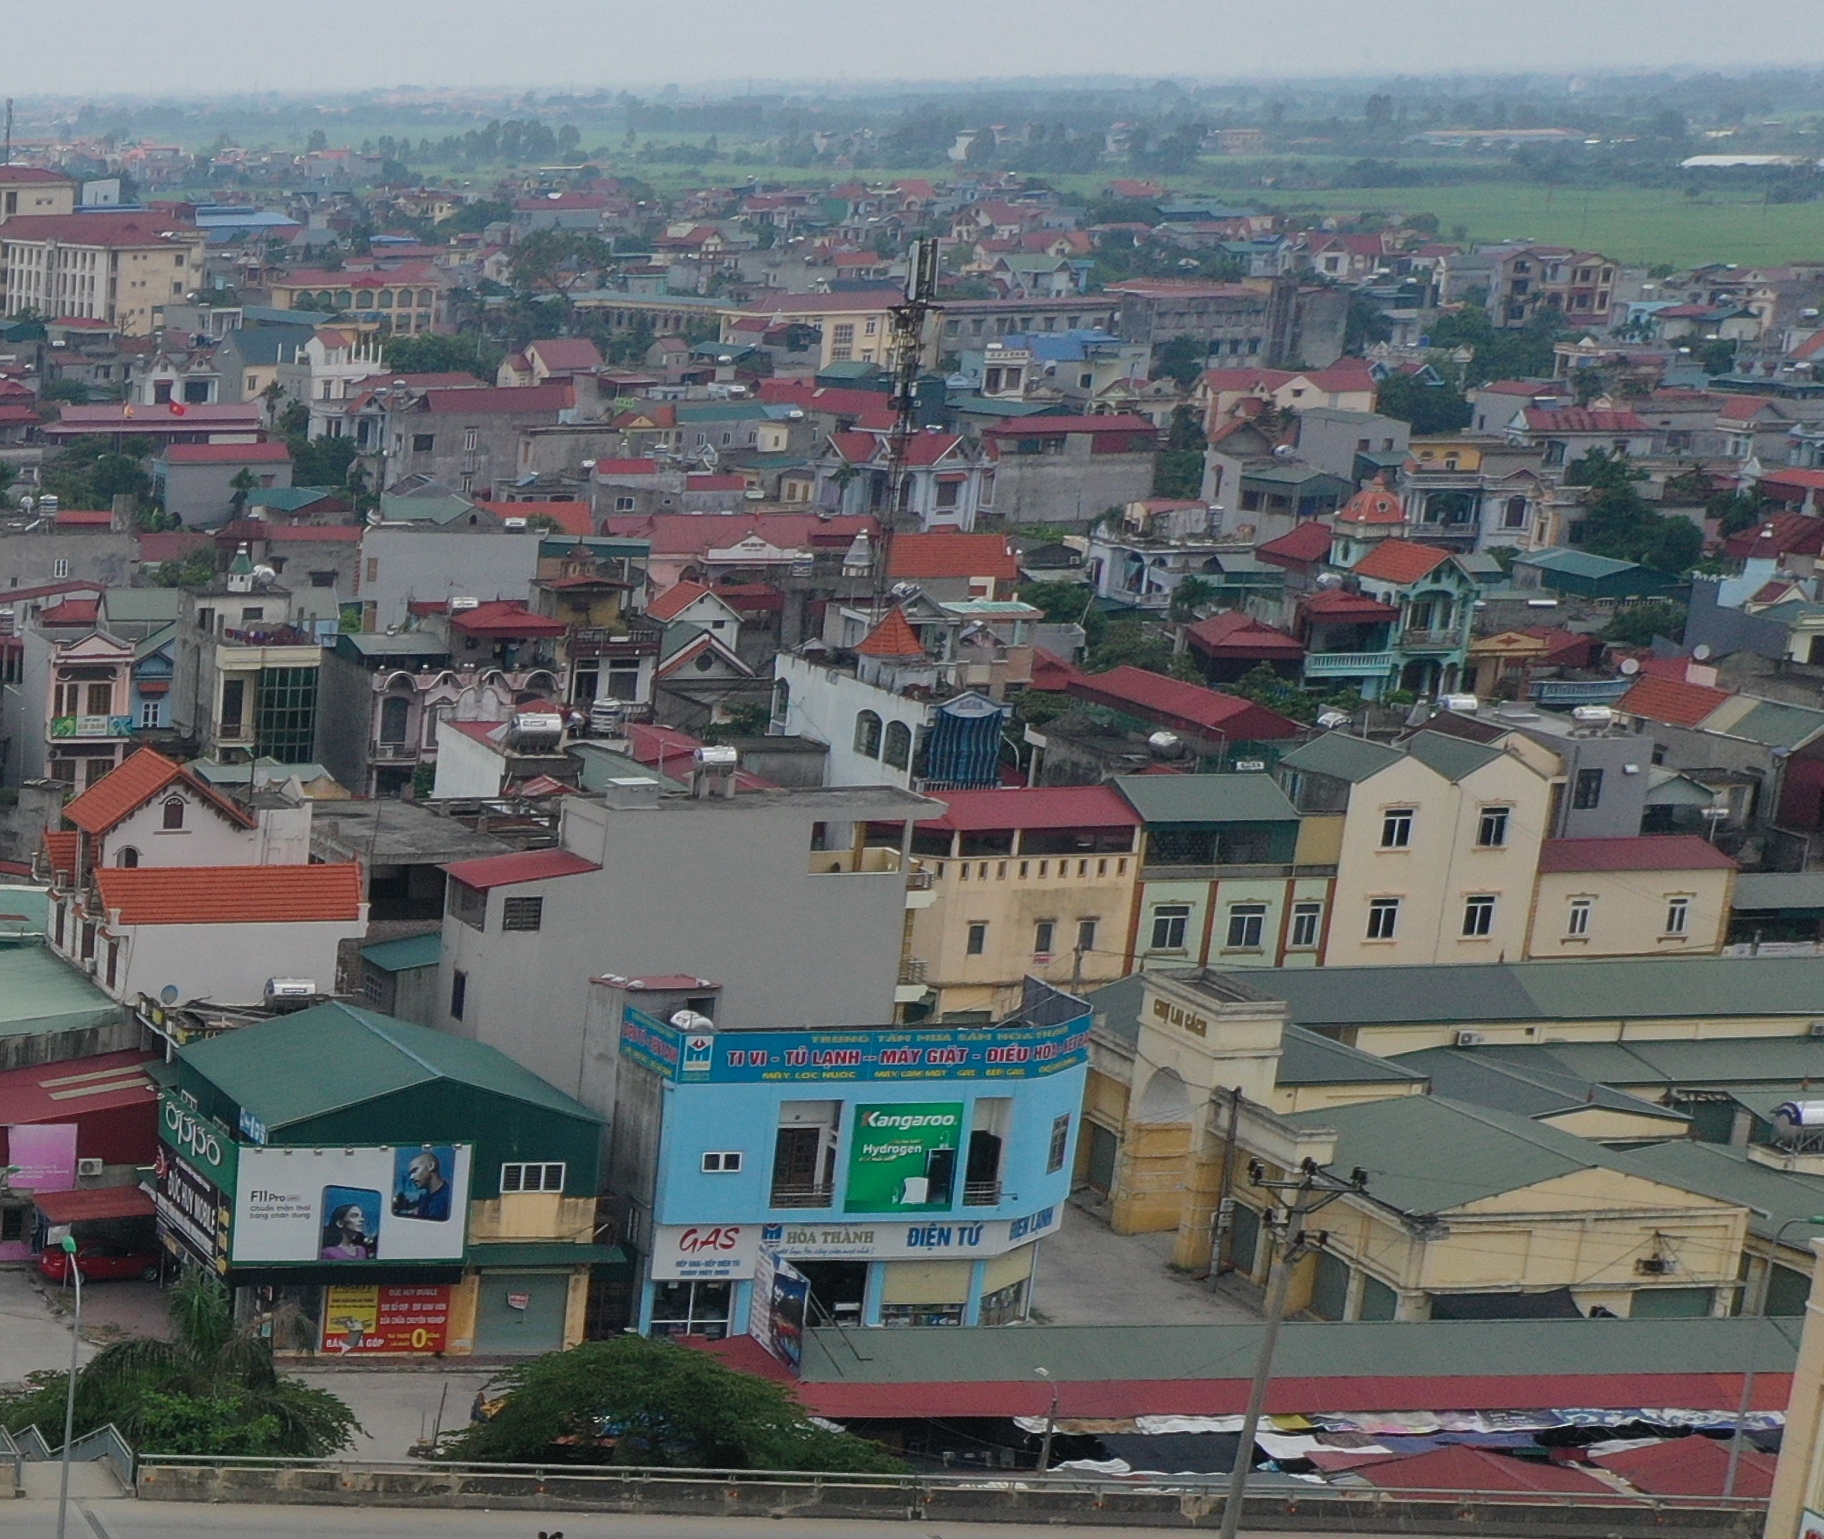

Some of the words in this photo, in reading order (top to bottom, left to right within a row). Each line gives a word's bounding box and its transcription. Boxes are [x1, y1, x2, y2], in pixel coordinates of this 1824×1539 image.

[727, 1050, 744, 1066] TI
[749, 1050, 767, 1066] VI
[784, 1046, 808, 1066] TỦ
[811, 1050, 862, 1069] LẠNH
[879, 1045, 922, 1065] MÁY
[926, 1044, 969, 1067] GIẶT
[861, 1111, 955, 1131] Kangaroo
[863, 1144, 922, 1157] Hydrogen
[250, 1191, 267, 1202] F11
[269, 1193, 286, 1202] Pro
[679, 1227, 740, 1253] GAS
[907, 1222, 951, 1251] ĐIỆN
[412, 1328, 427, 1348] 0
